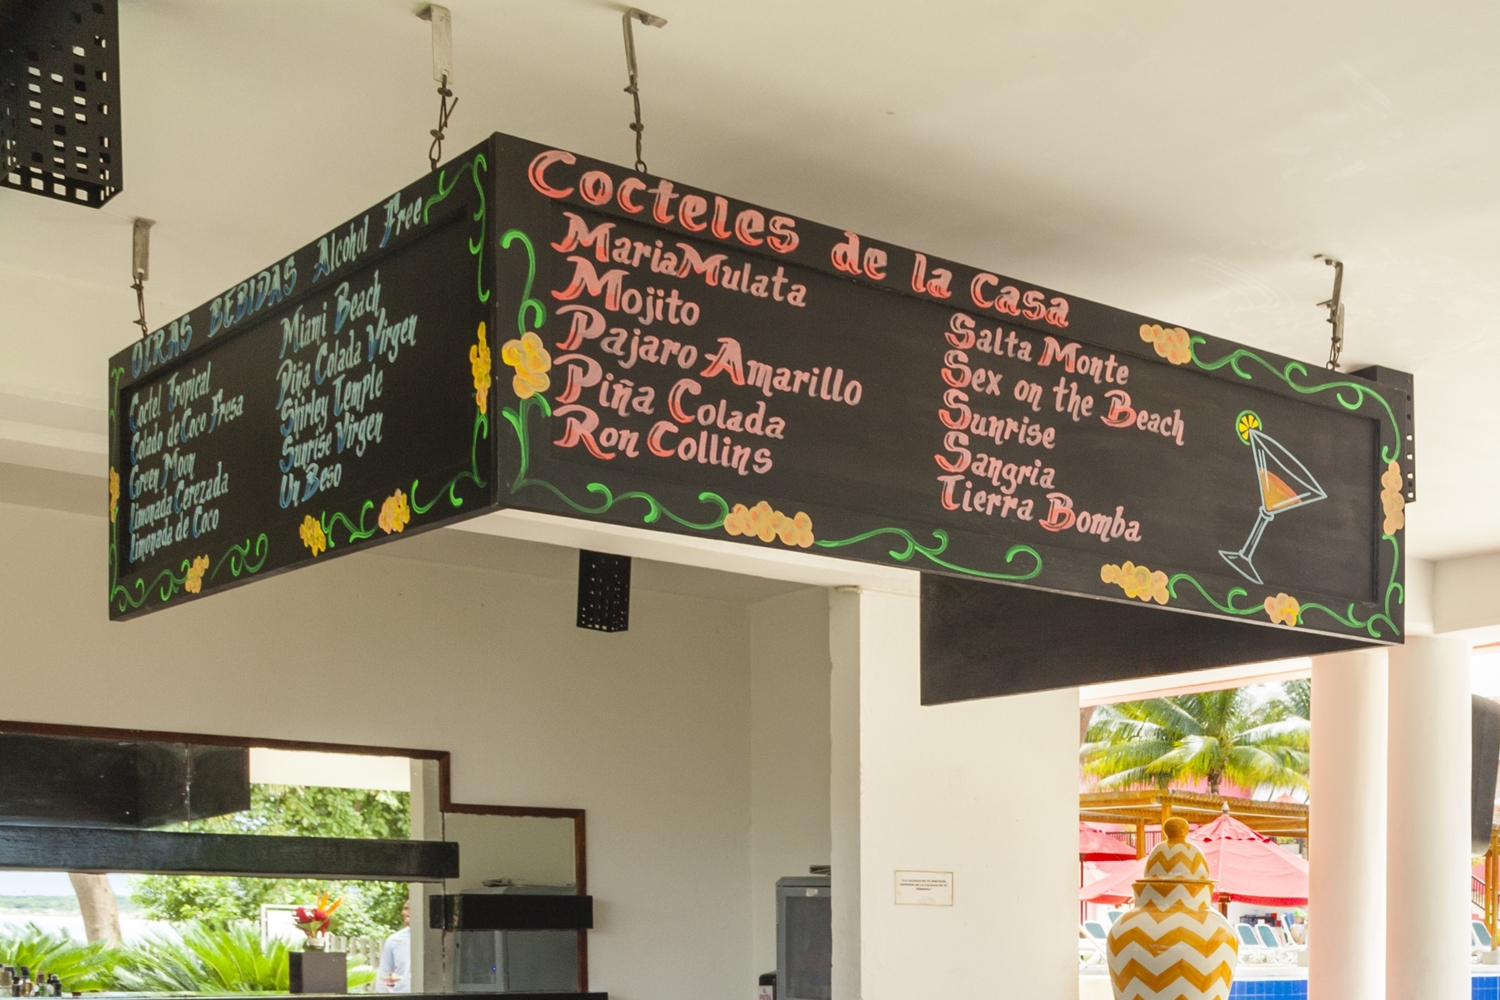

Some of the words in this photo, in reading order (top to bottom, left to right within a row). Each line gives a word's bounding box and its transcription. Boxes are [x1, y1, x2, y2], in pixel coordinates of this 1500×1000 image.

[528, 150, 800, 253] Cocteles
[830, 231, 888, 280] de
[912, 253, 952, 299] la
[970, 272, 1070, 328] Casa
[131, 313, 193, 379] OTRAS
[207, 255, 297, 338] BEBIDAS
[312, 214, 369, 284] Alcohol
[379, 191, 422, 248] Free
[278, 301, 327, 359] Miami
[333, 269, 381, 335] Beach
[551, 256, 700, 326] Mojito
[275, 358, 311, 410] Piña
[314, 329, 362, 385] Colada
[366, 307, 418, 363] Virgen
[555, 304, 698, 369] Pajaro
[700, 337, 863, 406] Amarillo
[944, 312, 1032, 362] Salta
[1037, 336, 1130, 385] Monte
[129, 384, 162, 433] Coctel
[167, 361, 211, 412] Tropical
[130, 421, 164, 465] Colado
[208, 388, 244, 434] Fresa
[280, 389, 329, 440] Shirley
[332, 363, 383, 417] Temple
[553, 353, 656, 417] Piña
[668, 378, 786, 440] Colada
[938, 388, 1056, 449] Sunrise
[941, 349, 1003, 396] Sex
[1014, 380, 1043, 412] on
[1053, 376, 1094, 422] the
[1100, 389, 1185, 446] Beach
[129, 464, 160, 500] Green
[160, 447, 196, 490] Moon
[279, 428, 333, 473] Sunrise
[334, 411, 383, 457] Virgen
[553, 404, 639, 460] Ron
[647, 420, 773, 476] Collins
[934, 430, 1056, 495] Sangria
[173, 460, 229, 515] Cerezada
[279, 473, 300, 509] Un
[301, 462, 342, 502] Beso
[937, 474, 1034, 522] Tierra
[1038, 492, 1142, 543] Bomba
[175, 511, 189, 542] de
[192, 505, 219, 538] Coco
